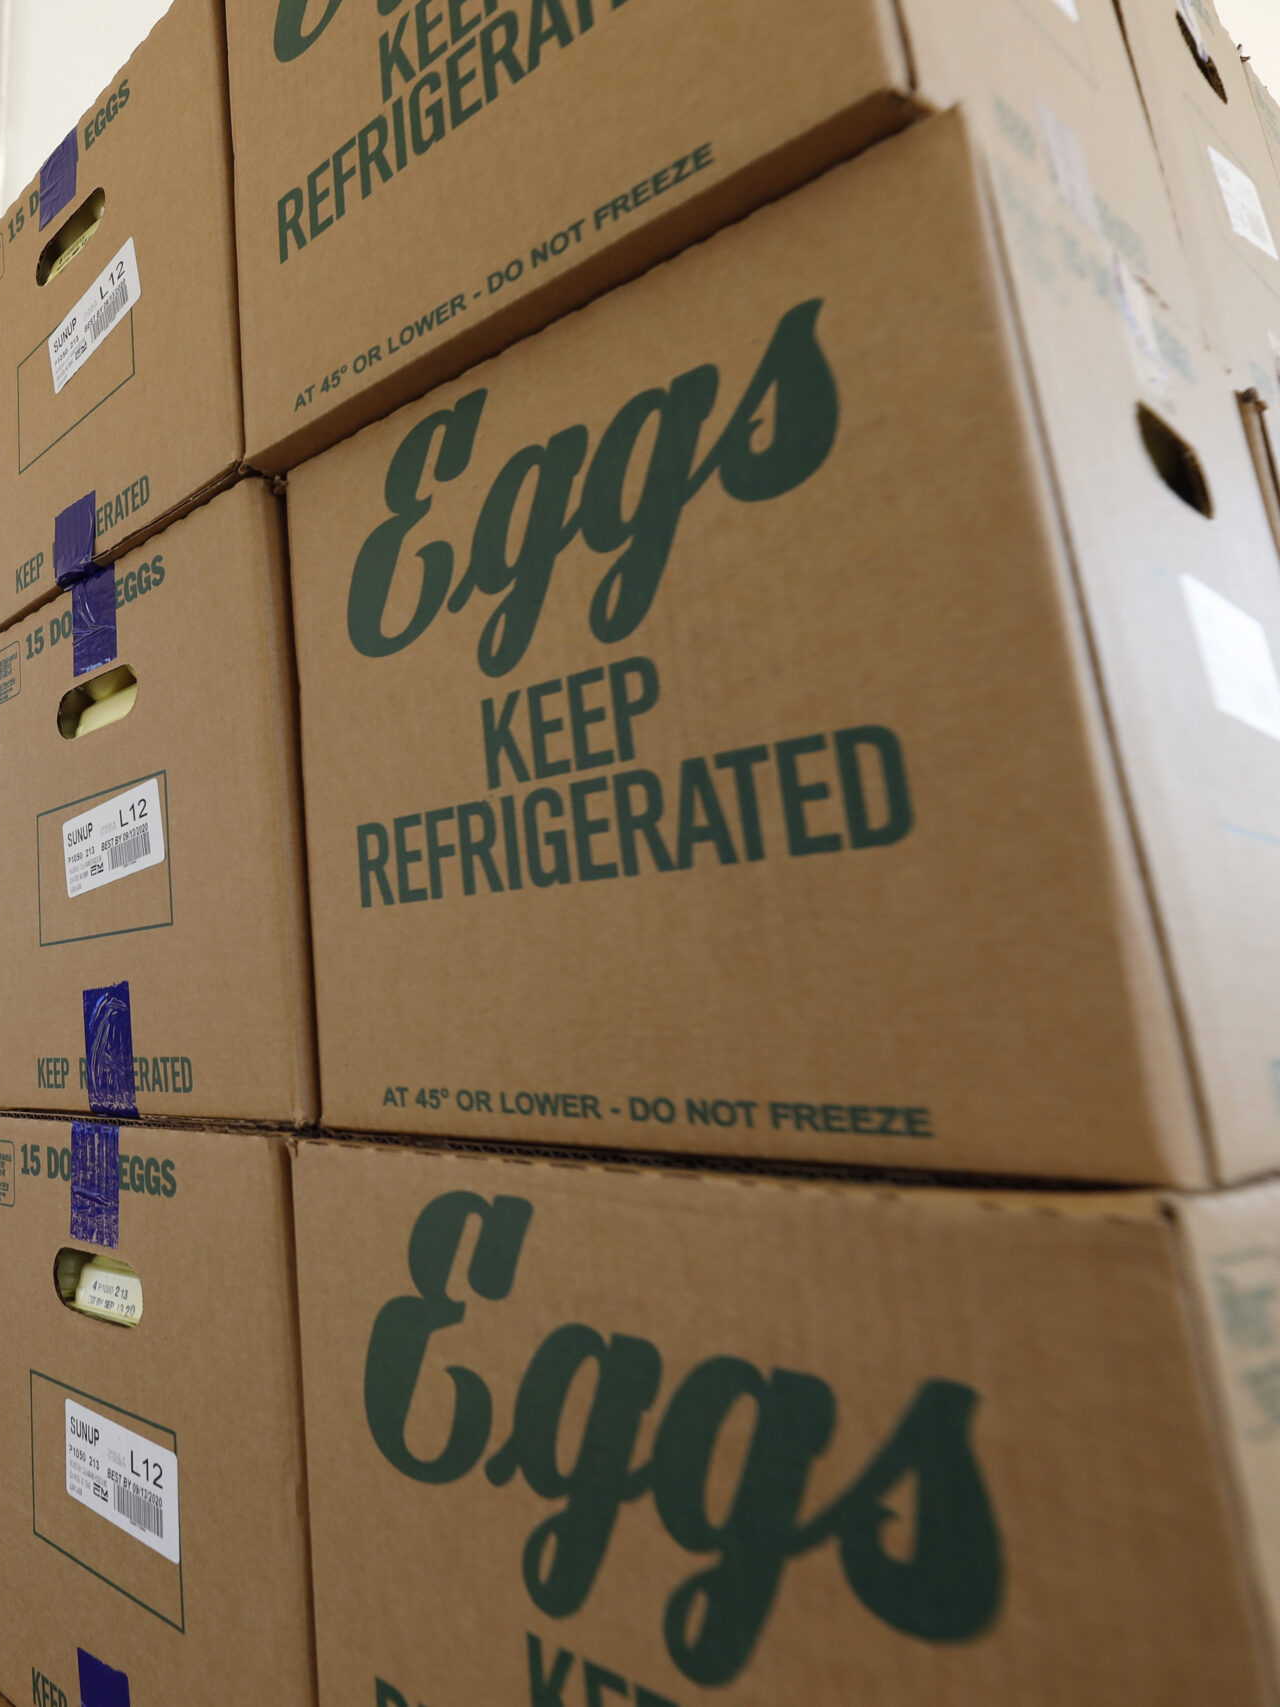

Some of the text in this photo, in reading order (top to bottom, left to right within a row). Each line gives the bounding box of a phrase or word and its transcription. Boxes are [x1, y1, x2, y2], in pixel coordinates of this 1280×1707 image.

[379, 0, 499, 104] KEE
[84, 78, 131, 151] EGGS
[277, 0, 630, 265] REFRIGERA
[7, 206, 25, 243] 15
[99, 260, 126, 300] L12
[293, 385, 316, 412] AT
[352, 345, 383, 376] OR
[386, 293, 469, 354] LOWER
[486, 260, 524, 296] DO
[530, 219, 586, 270] NOT
[593, 142, 715, 231] FREEZE
[53, 316, 77, 353] SUNUP
[347, 297, 840, 679] Eggs
[15, 551, 44, 594] KEEP
[25, 626, 45, 661] 15
[115, 554, 166, 610] EGGS
[480, 655, 661, 791] KEEP
[67, 822, 94, 848] SUNUP
[119, 798, 148, 828] L12
[356, 724, 916, 909] REFRIGERATED
[85, 846, 96, 858] 213
[101, 838, 114, 851] BEST
[115, 835, 122, 845] BY
[37, 1056, 194, 1094] KEEP RERATED
[382, 1086, 409, 1108] AT
[455, 1089, 493, 1113] OR
[500, 1091, 602, 1121] LOWER
[629, 1095, 677, 1125] DO
[684, 1098, 757, 1130] NOT
[768, 1102, 935, 1138] FREEZE
[21, 1143, 41, 1177] 15
[119, 1154, 177, 1198] EGGS
[92, 1280, 97, 1291] 4
[125, 1305, 136, 1317] 20
[70, 1416, 100, 1447] SUNUP
[130, 1450, 163, 1489] L12
[363, 1190, 1005, 1690] Eggs
[89, 1455, 100, 1471] 213
[107, 1467, 122, 1484] BEST
[123, 1476, 132, 1490] BY
